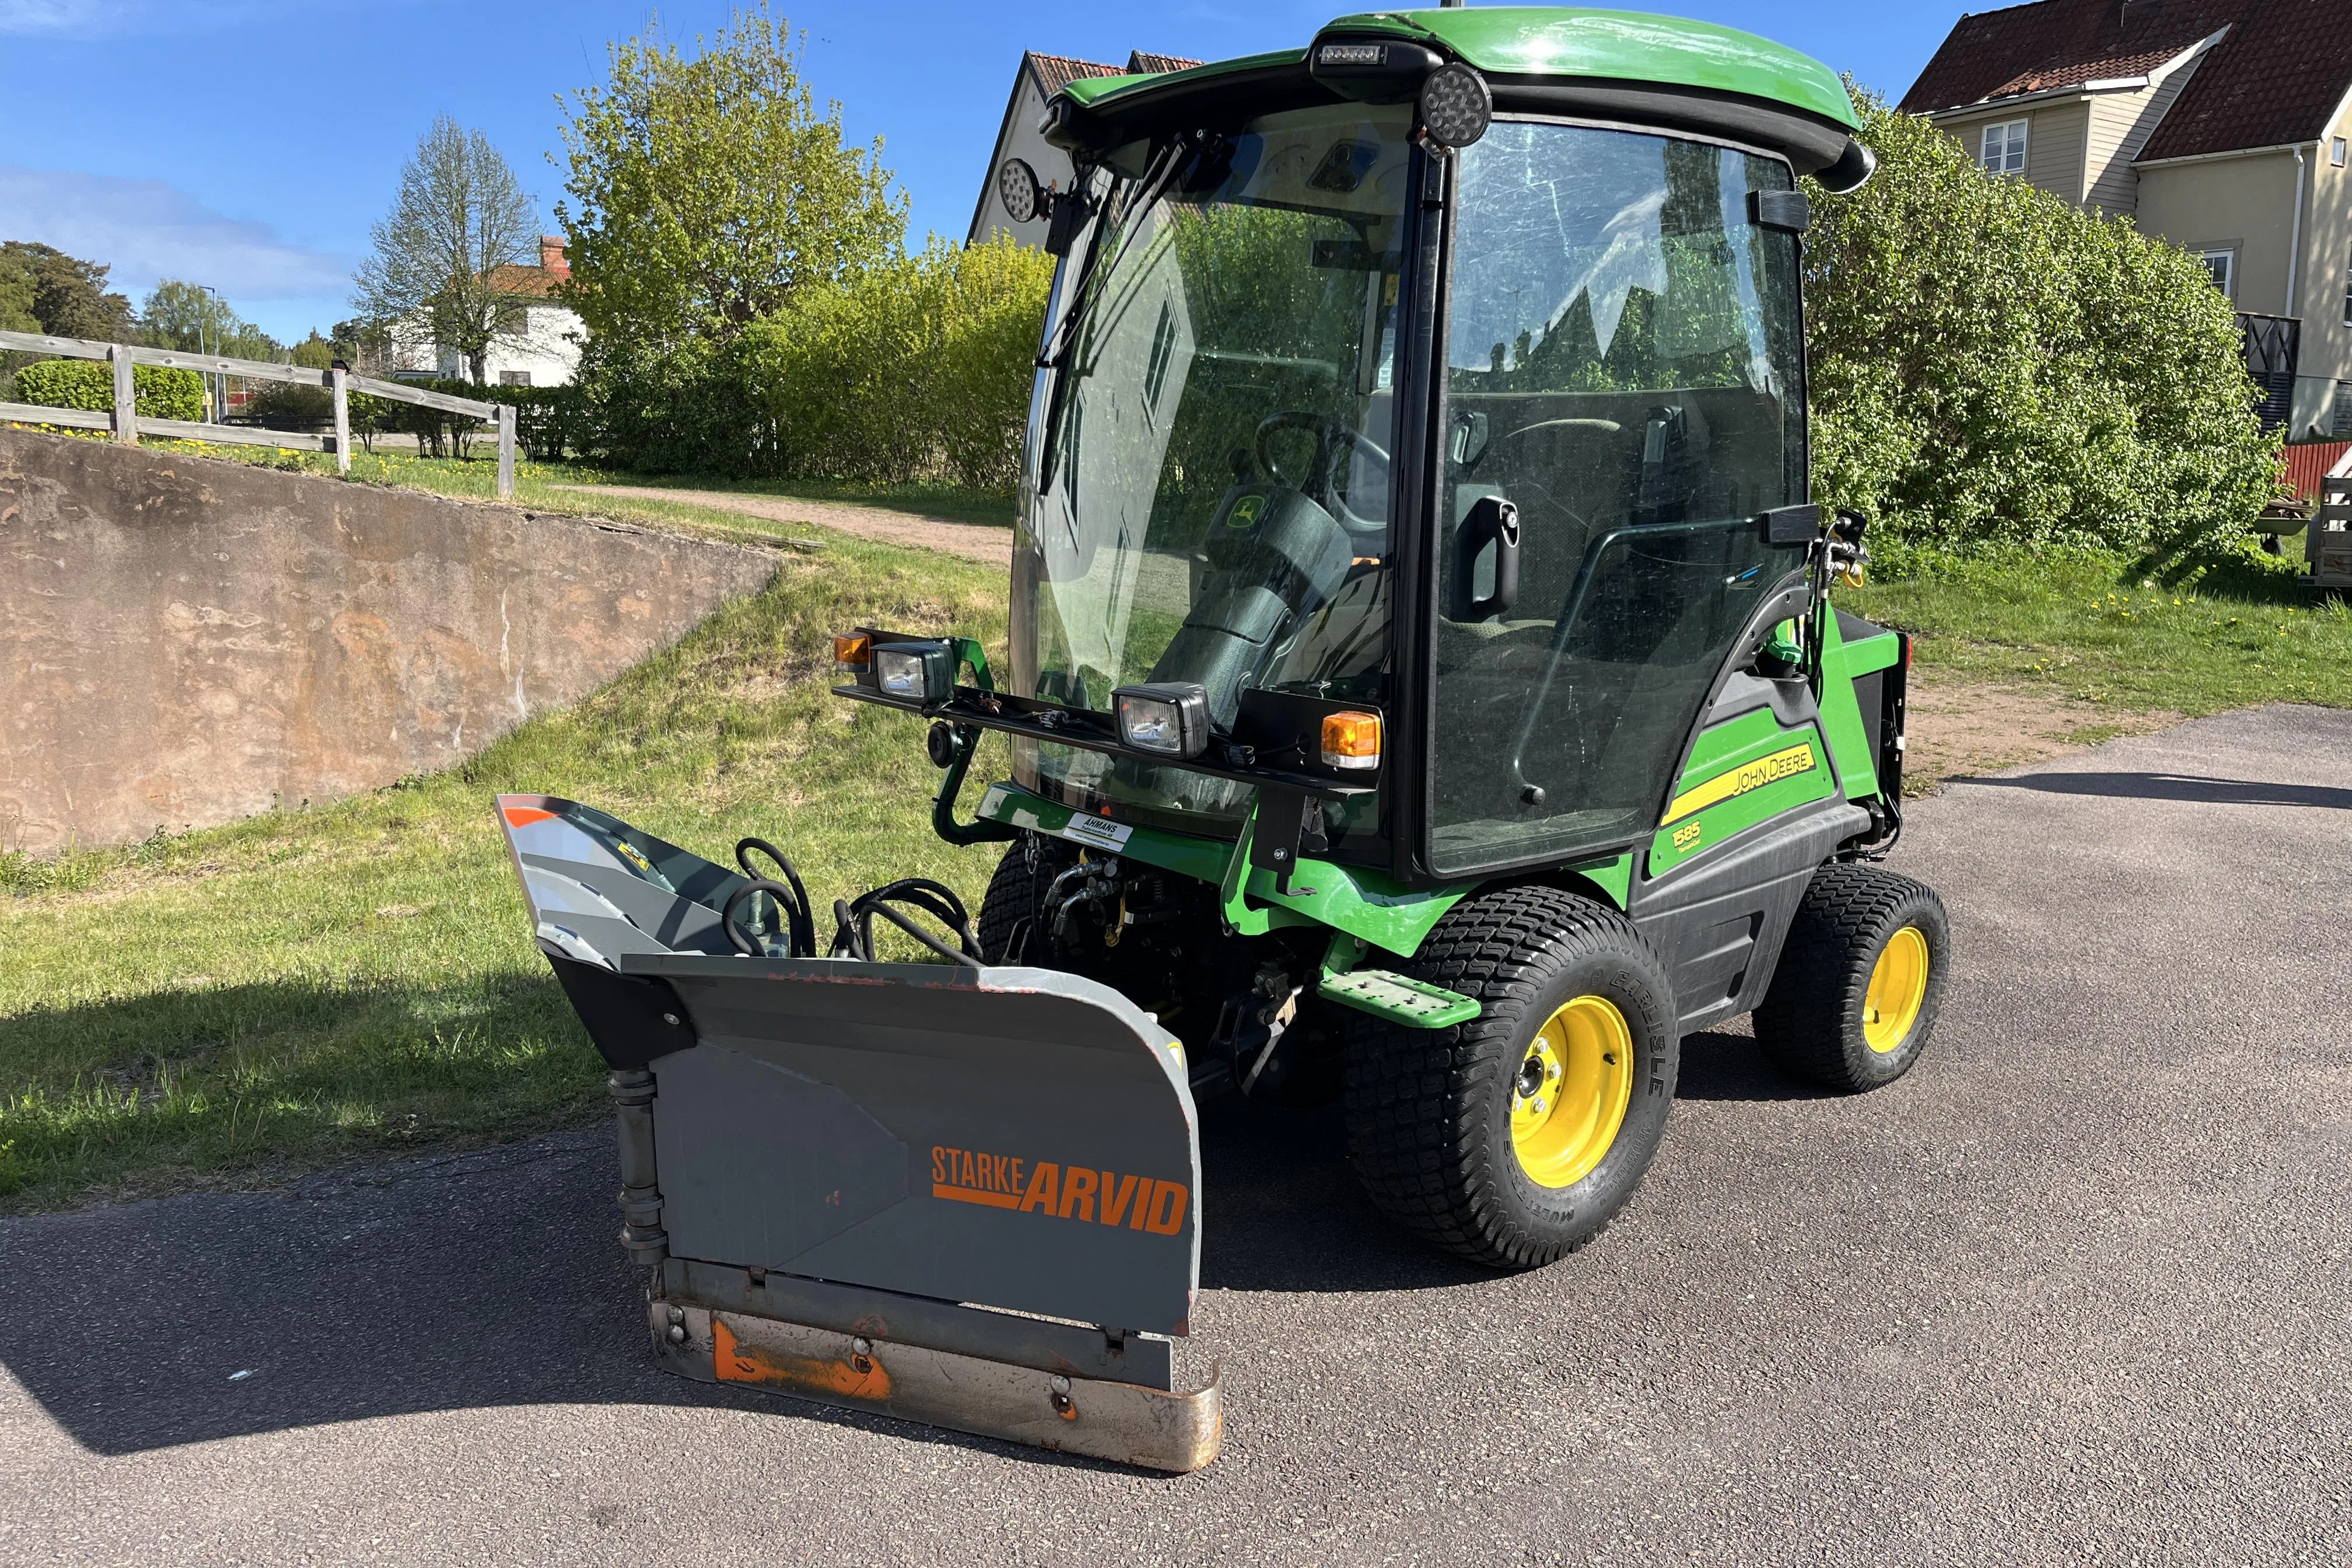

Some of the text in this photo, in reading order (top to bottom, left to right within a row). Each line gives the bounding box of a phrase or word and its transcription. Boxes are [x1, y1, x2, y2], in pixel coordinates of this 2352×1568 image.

[1734, 752, 1807, 793] JOHN DEERE
[1083, 816, 1118, 833] ÅHMANS
[1672, 820, 1701, 848] 1585
[1609, 970, 1666, 1098] CARLISLE
[932, 1146, 1189, 1236] STARKE ARVID
[1525, 1199, 1575, 1224] MULTI
